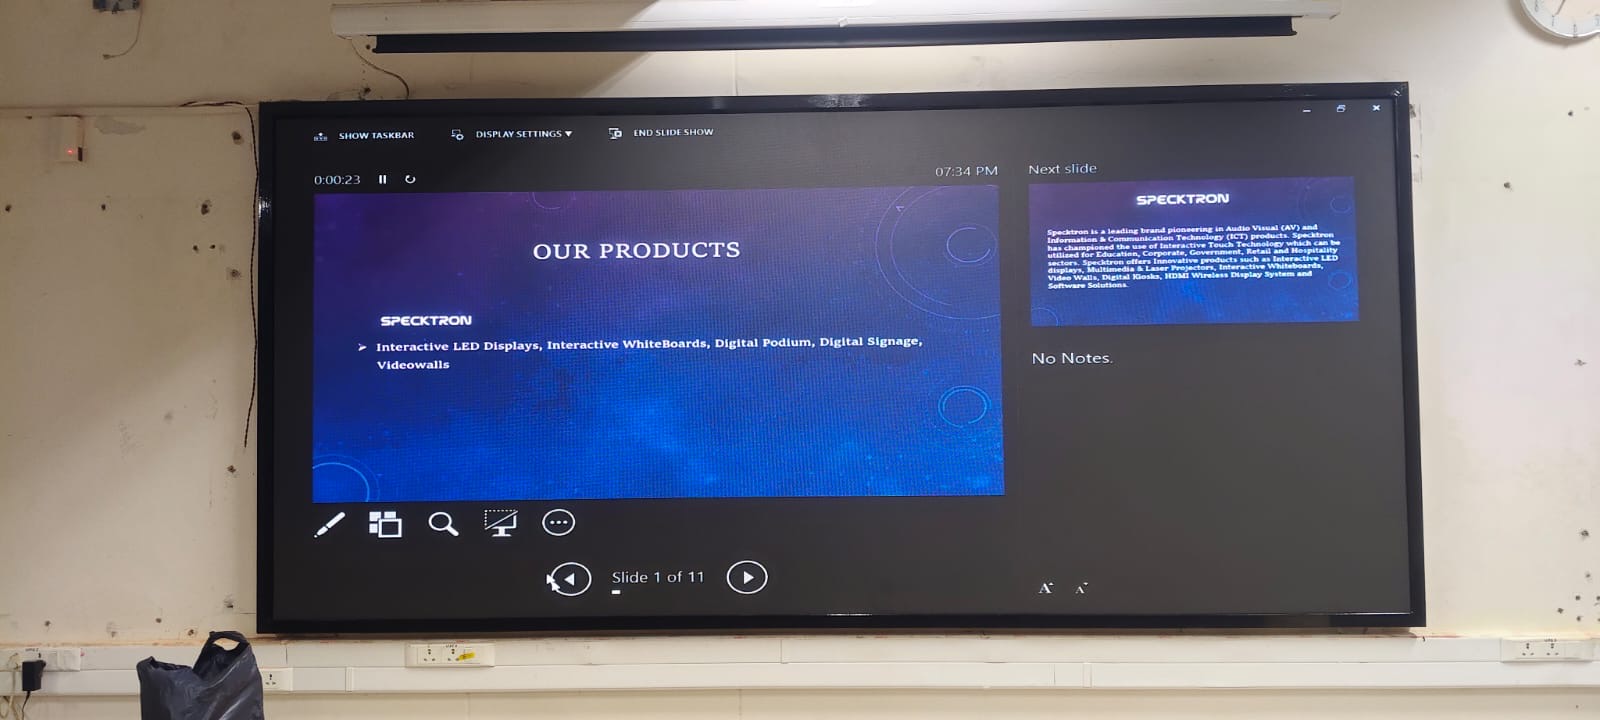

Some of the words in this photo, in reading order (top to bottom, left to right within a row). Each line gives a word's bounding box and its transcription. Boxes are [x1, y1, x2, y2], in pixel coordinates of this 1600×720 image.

[476, 130, 514, 139] DISPLAY
[516, 130, 562, 138] SETTINGS
[634, 129, 654, 137] END
[656, 128, 682, 137] SLIDE
[684, 128, 714, 137] SHOW
[935, 166, 971, 177] 07:34
[976, 166, 998, 176] PM
[1029, 164, 1060, 175] Next
[1064, 163, 1097, 174] slide
[314, 175, 361, 185] 0:00:23
[1136, 193, 1230, 205] SPECKTRON
[1168, 226, 1213, 235] pioneering
[533, 243, 591, 260] OUR
[599, 241, 741, 259] PRODUCTS
[380, 315, 472, 327] SPECKTRON
[376, 341, 449, 352] Interactive
[453, 342, 480, 352] LED
[484, 340, 543, 353] Displays,
[547, 340, 619, 350] Interactive
[622, 339, 711, 351] WhiteBoards,
[715, 338, 759, 351] Digital
[763, 336, 815, 350] Podium,
[819, 336, 864, 350] Digital
[867, 336, 923, 349] Signage,
[1032, 353, 1056, 364] No
[1062, 352, 1113, 364] Notes.
[377, 359, 450, 370] Videowalls
[612, 571, 648, 583] Slide
[654, 572, 660, 583] 1
[667, 570, 683, 583] of
[688, 571, 704, 583] 11
